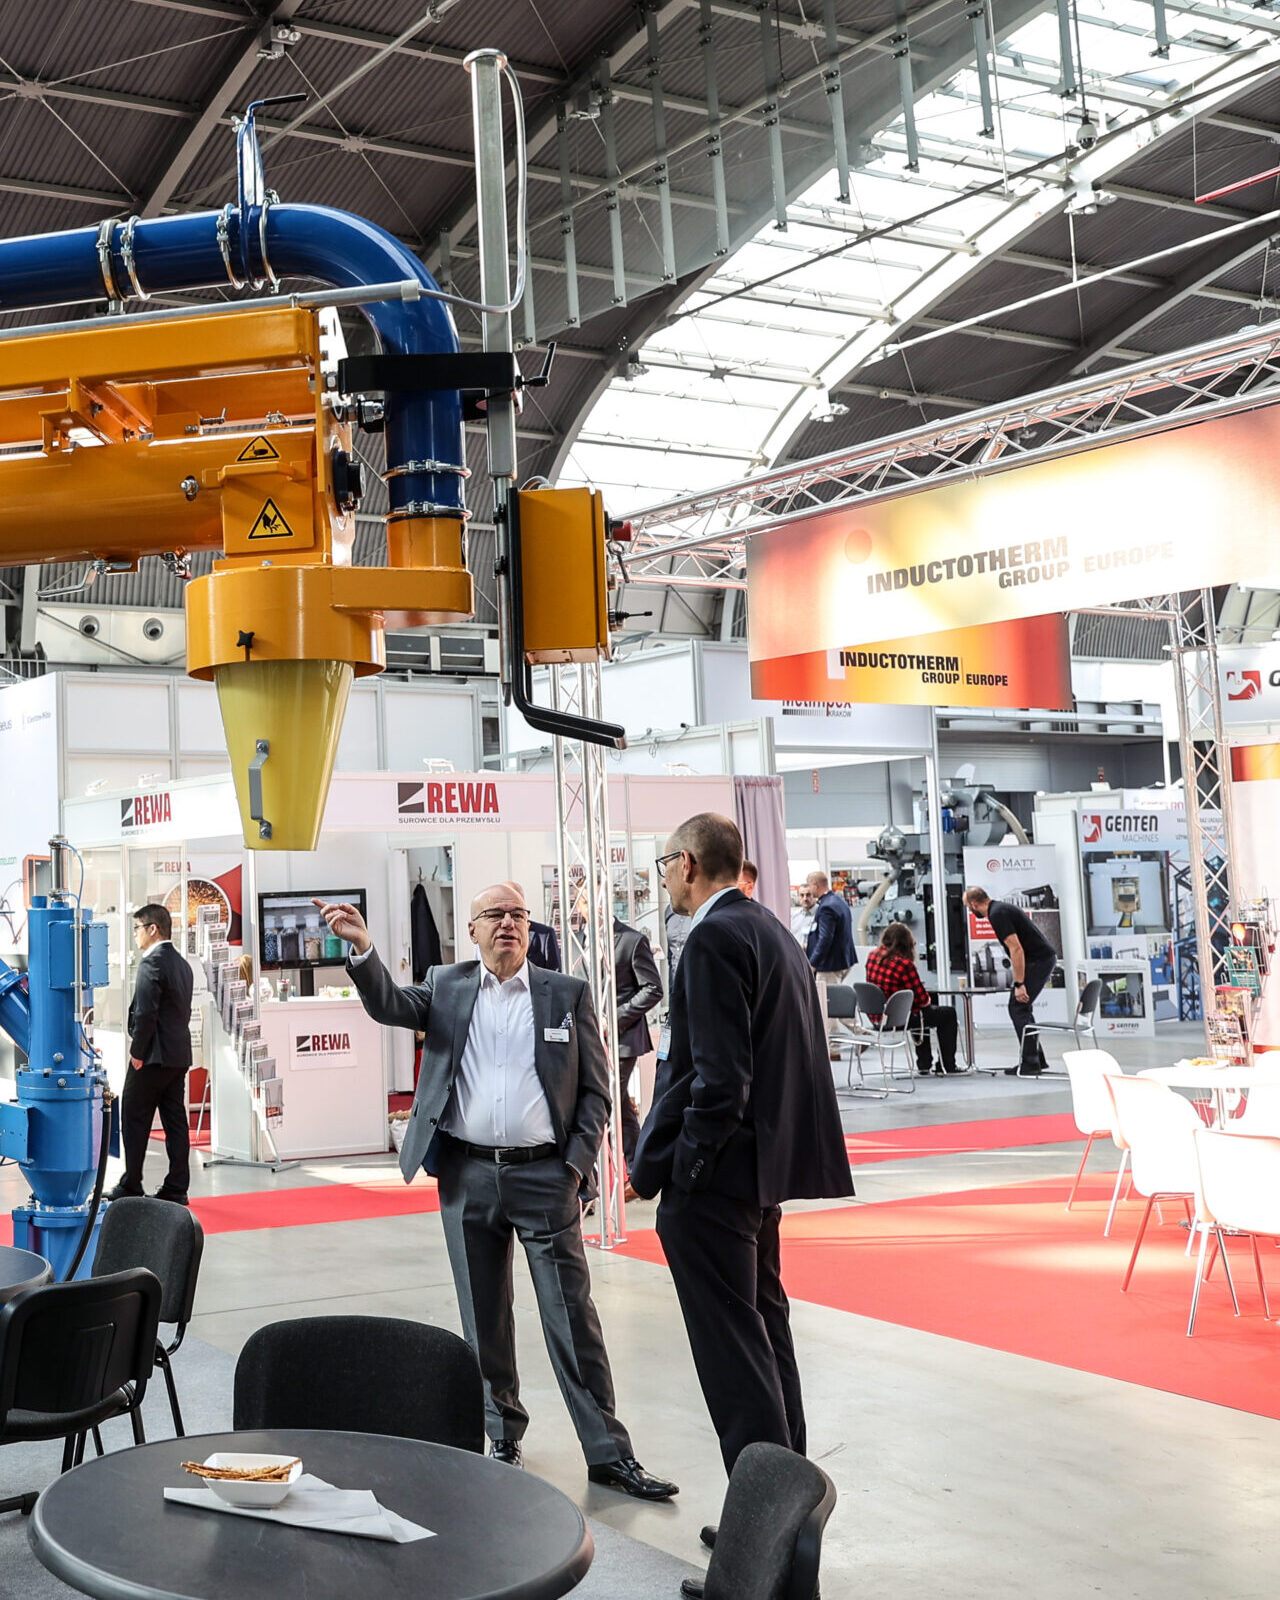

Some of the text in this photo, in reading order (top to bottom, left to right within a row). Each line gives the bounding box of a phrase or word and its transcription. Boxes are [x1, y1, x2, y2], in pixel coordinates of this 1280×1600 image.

[867, 536, 1068, 594] INDUCTOTHERM
[999, 541, 1175, 589] GROUP EUROPE
[839, 651, 959, 672] INDUCTOTHERM
[922, 671, 1008, 687] GROUP EUROPE
[427, 782, 499, 813] REWA
[134, 792, 172, 826] REWA
[1105, 815, 1158, 832] GENTEN
[1122, 834, 1159, 843] MACHINES
[611, 847, 626, 863] EW
[312, 1033, 351, 1052] REWA
